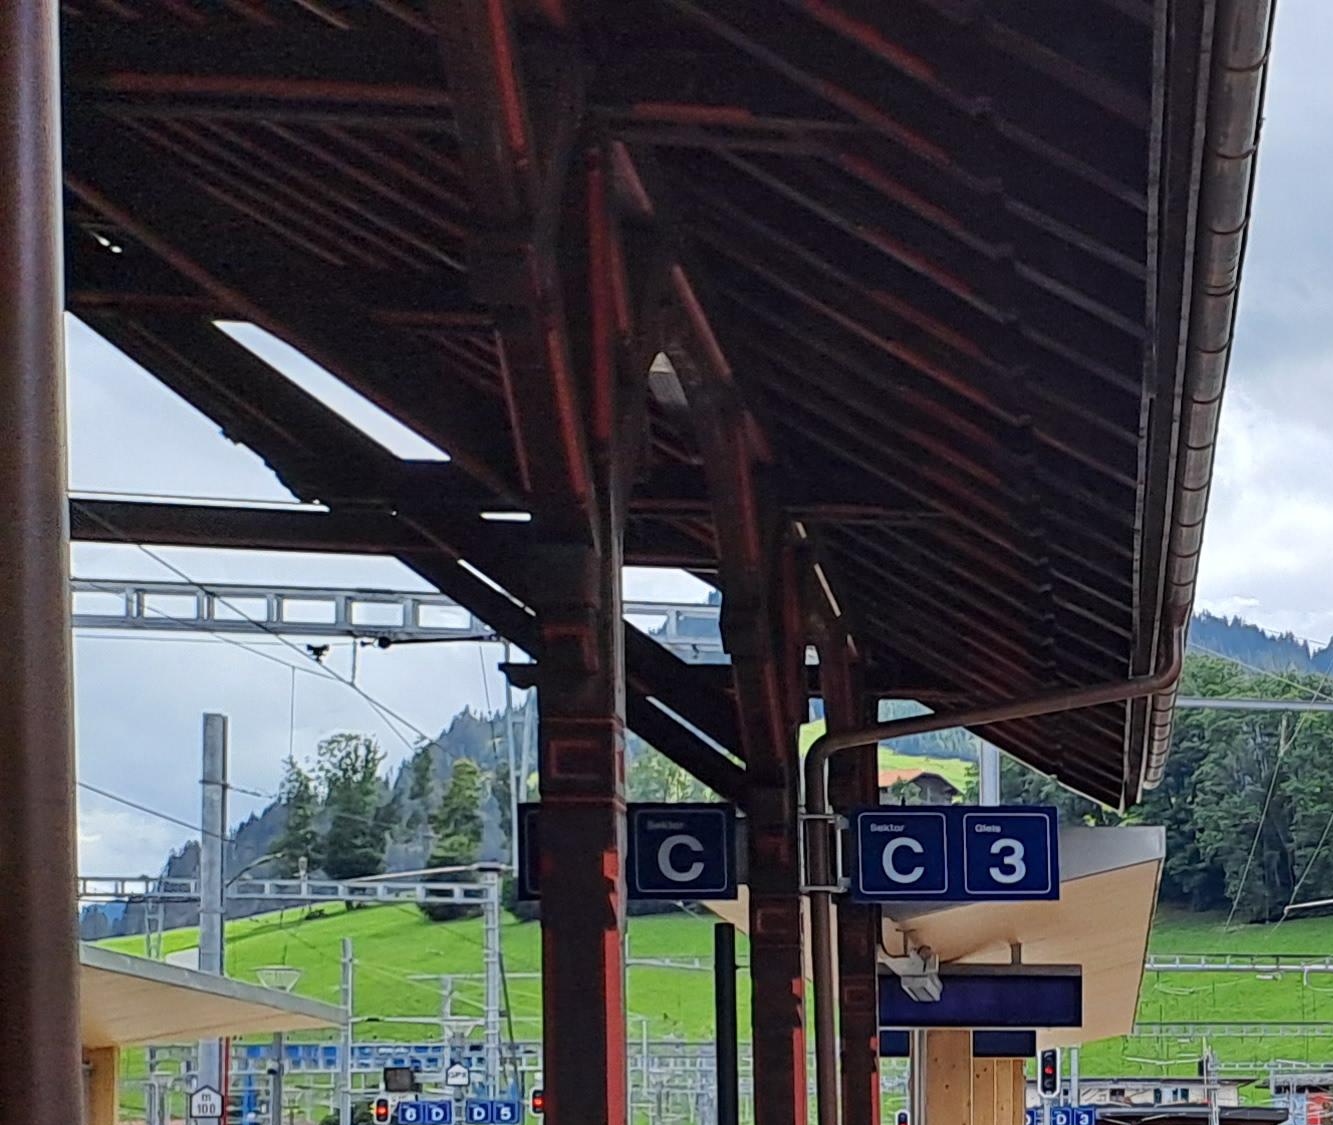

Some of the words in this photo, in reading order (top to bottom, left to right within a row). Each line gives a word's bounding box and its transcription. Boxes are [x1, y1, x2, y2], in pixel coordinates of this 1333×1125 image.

[657, 834, 705, 882] C
[882, 836, 925, 884] C
[989, 838, 1027, 884] 3
[197, 1103, 216, 1115] 100
[431, 1107, 444, 1121] D
[473, 1107, 486, 1120] D
[500, 1106, 512, 1120] 5
[1056, 1113, 1067, 1125] D
